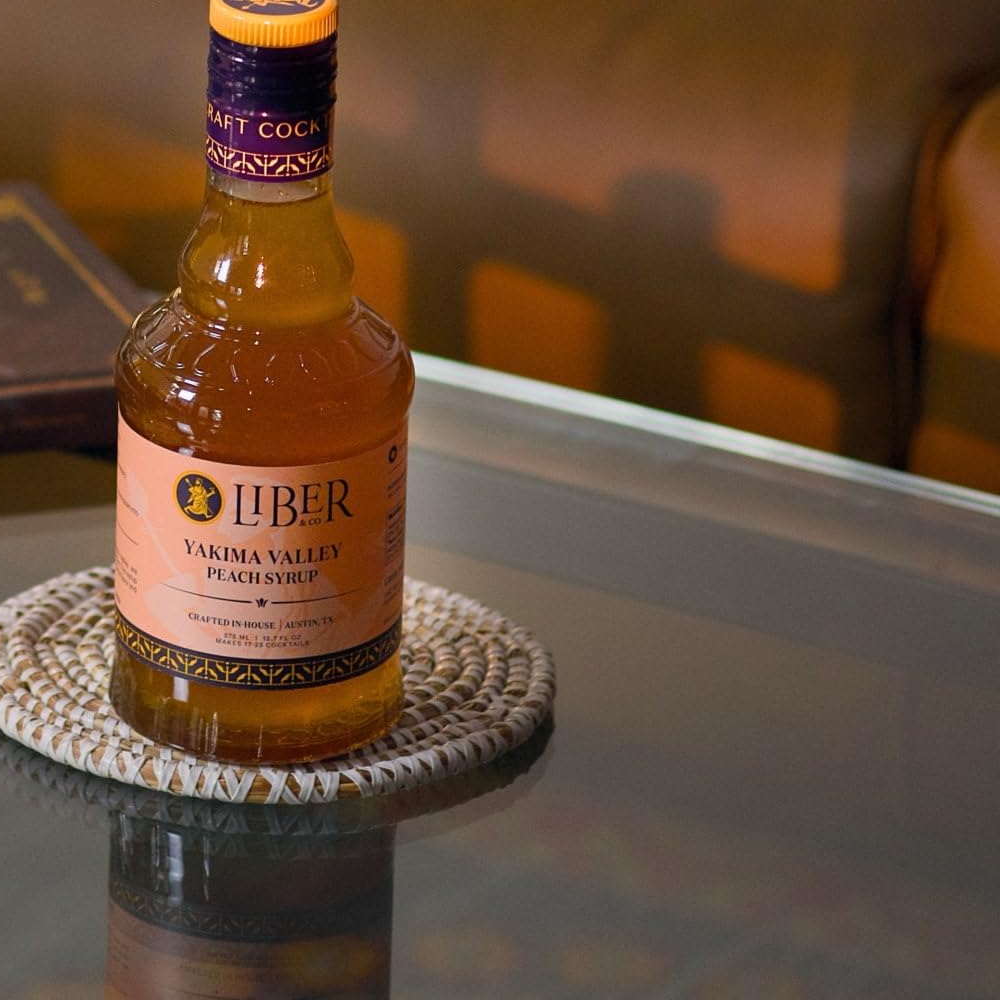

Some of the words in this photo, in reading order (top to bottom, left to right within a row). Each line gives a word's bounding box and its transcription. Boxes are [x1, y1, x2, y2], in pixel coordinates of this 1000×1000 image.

[233, 479, 355, 527] LIBER
[184, 539, 262, 564] YAKIMA
[267, 542, 343, 565] VALLEY
[207, 566, 260, 585] PEACH
[265, 569, 319, 585] SYRUP
[188, 613, 230, 626] CRAFTED
[231, 620, 276, 630] IN-HOUSE
[284, 618, 320, 630] AUSTIN,
[322, 616, 334, 626] TX
[215, 638, 242, 646] MAKES
[265, 640, 310, 648] COCKTAILS
